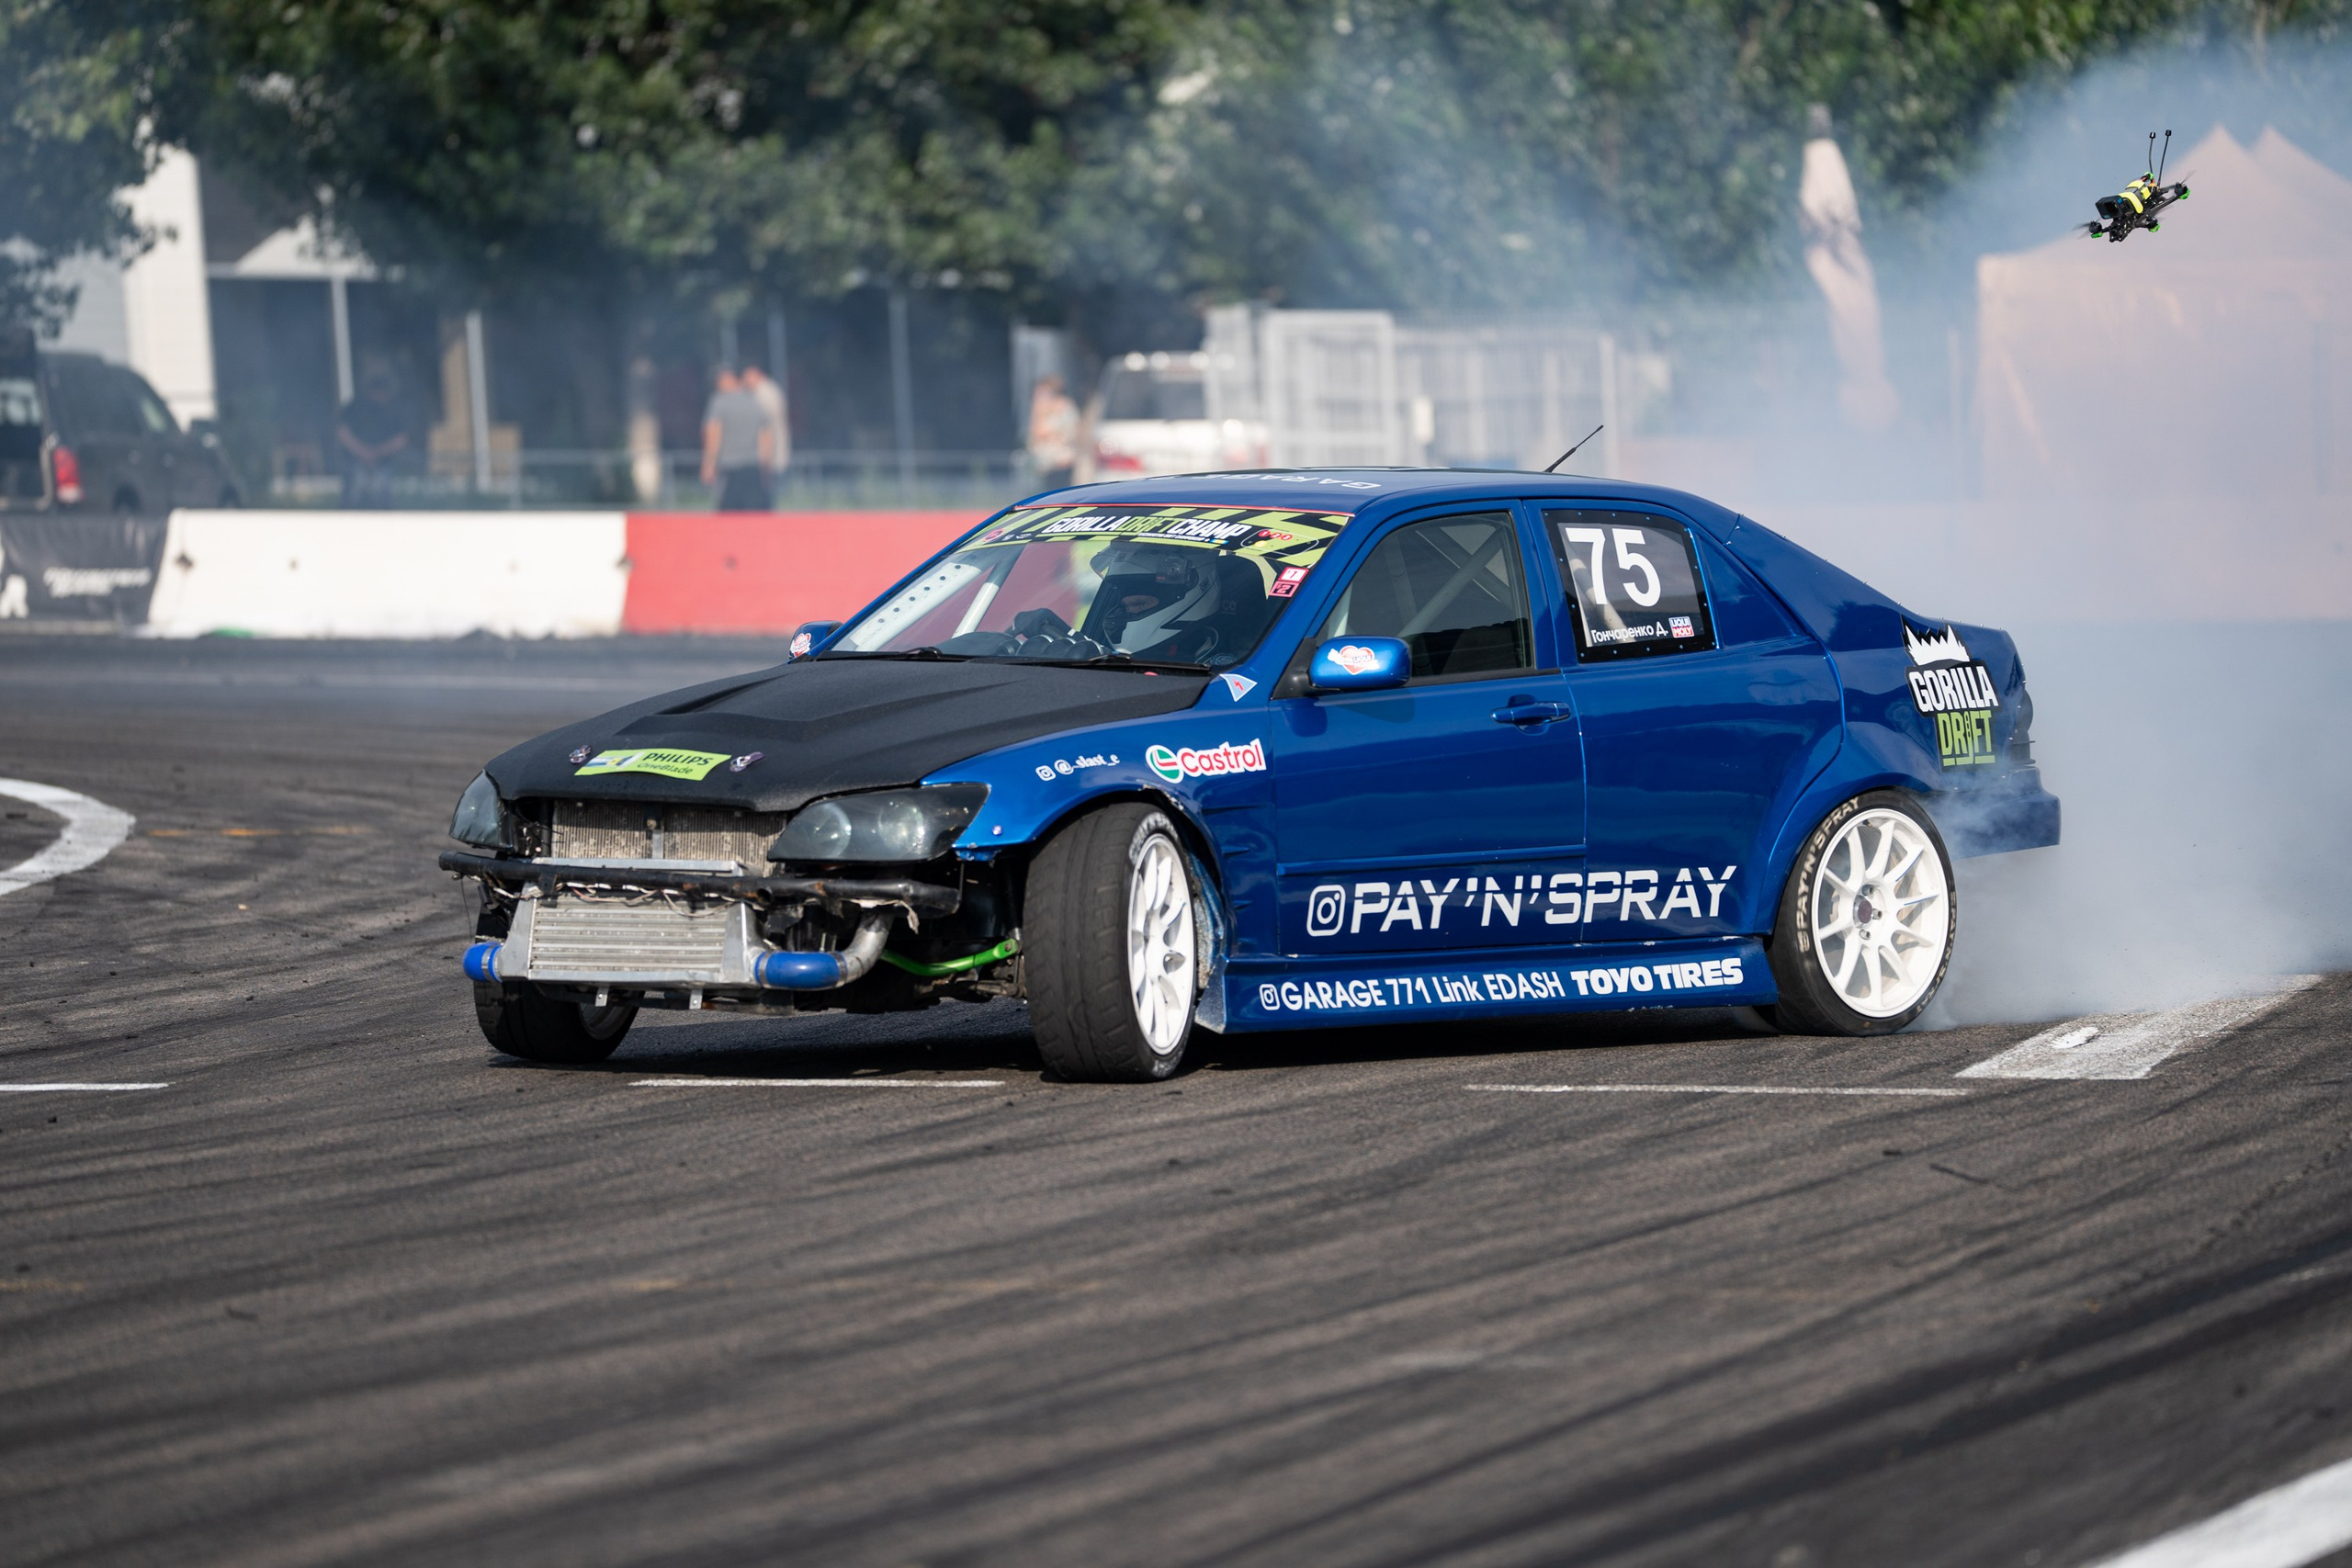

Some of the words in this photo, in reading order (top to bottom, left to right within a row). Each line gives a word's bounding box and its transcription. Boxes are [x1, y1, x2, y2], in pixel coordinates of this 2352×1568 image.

[1565, 527, 1662, 607] 75
[1590, 625, 1655, 643] Гончаренко
[1671, 617, 1690, 627] LIQUI
[1673, 626, 1693, 637] MOLY
[1908, 666, 1998, 713] GORILLA
[1937, 710, 1994, 764] DRIFT
[642, 752, 714, 766] PHILIPS
[1181, 743, 1264, 773] Castrol
[1351, 865, 1738, 934] PAY'N'SPRAY
[1281, 979, 1387, 1010] GARAGE
[1385, 977, 1432, 1005] 771
[1431, 975, 1486, 1003] Link
[1482, 971, 1566, 1000] EDASH
[1570, 965, 1655, 996] TOYO
[1654, 957, 1744, 990] TIRES
